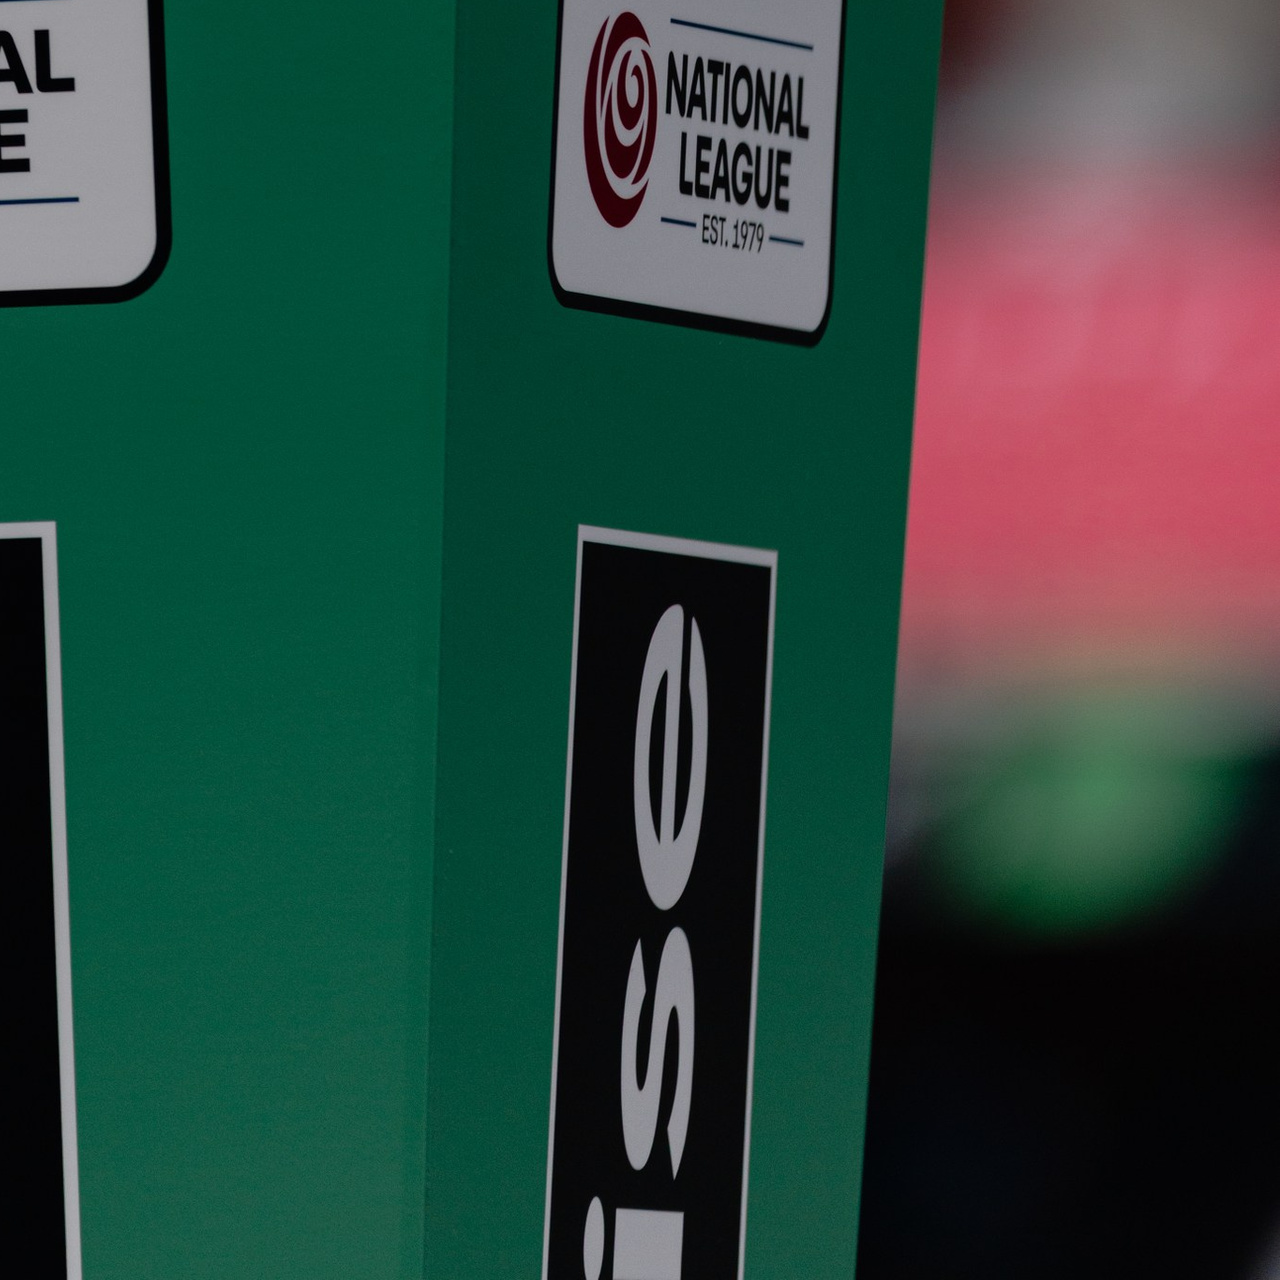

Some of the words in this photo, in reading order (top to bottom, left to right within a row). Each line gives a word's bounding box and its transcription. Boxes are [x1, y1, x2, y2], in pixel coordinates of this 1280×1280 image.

[664, 50, 810, 140] NATIONAL
[677, 130, 793, 214] LEAGUE
[701, 215, 730, 249] EST.
[731, 221, 765, 254] 1979
